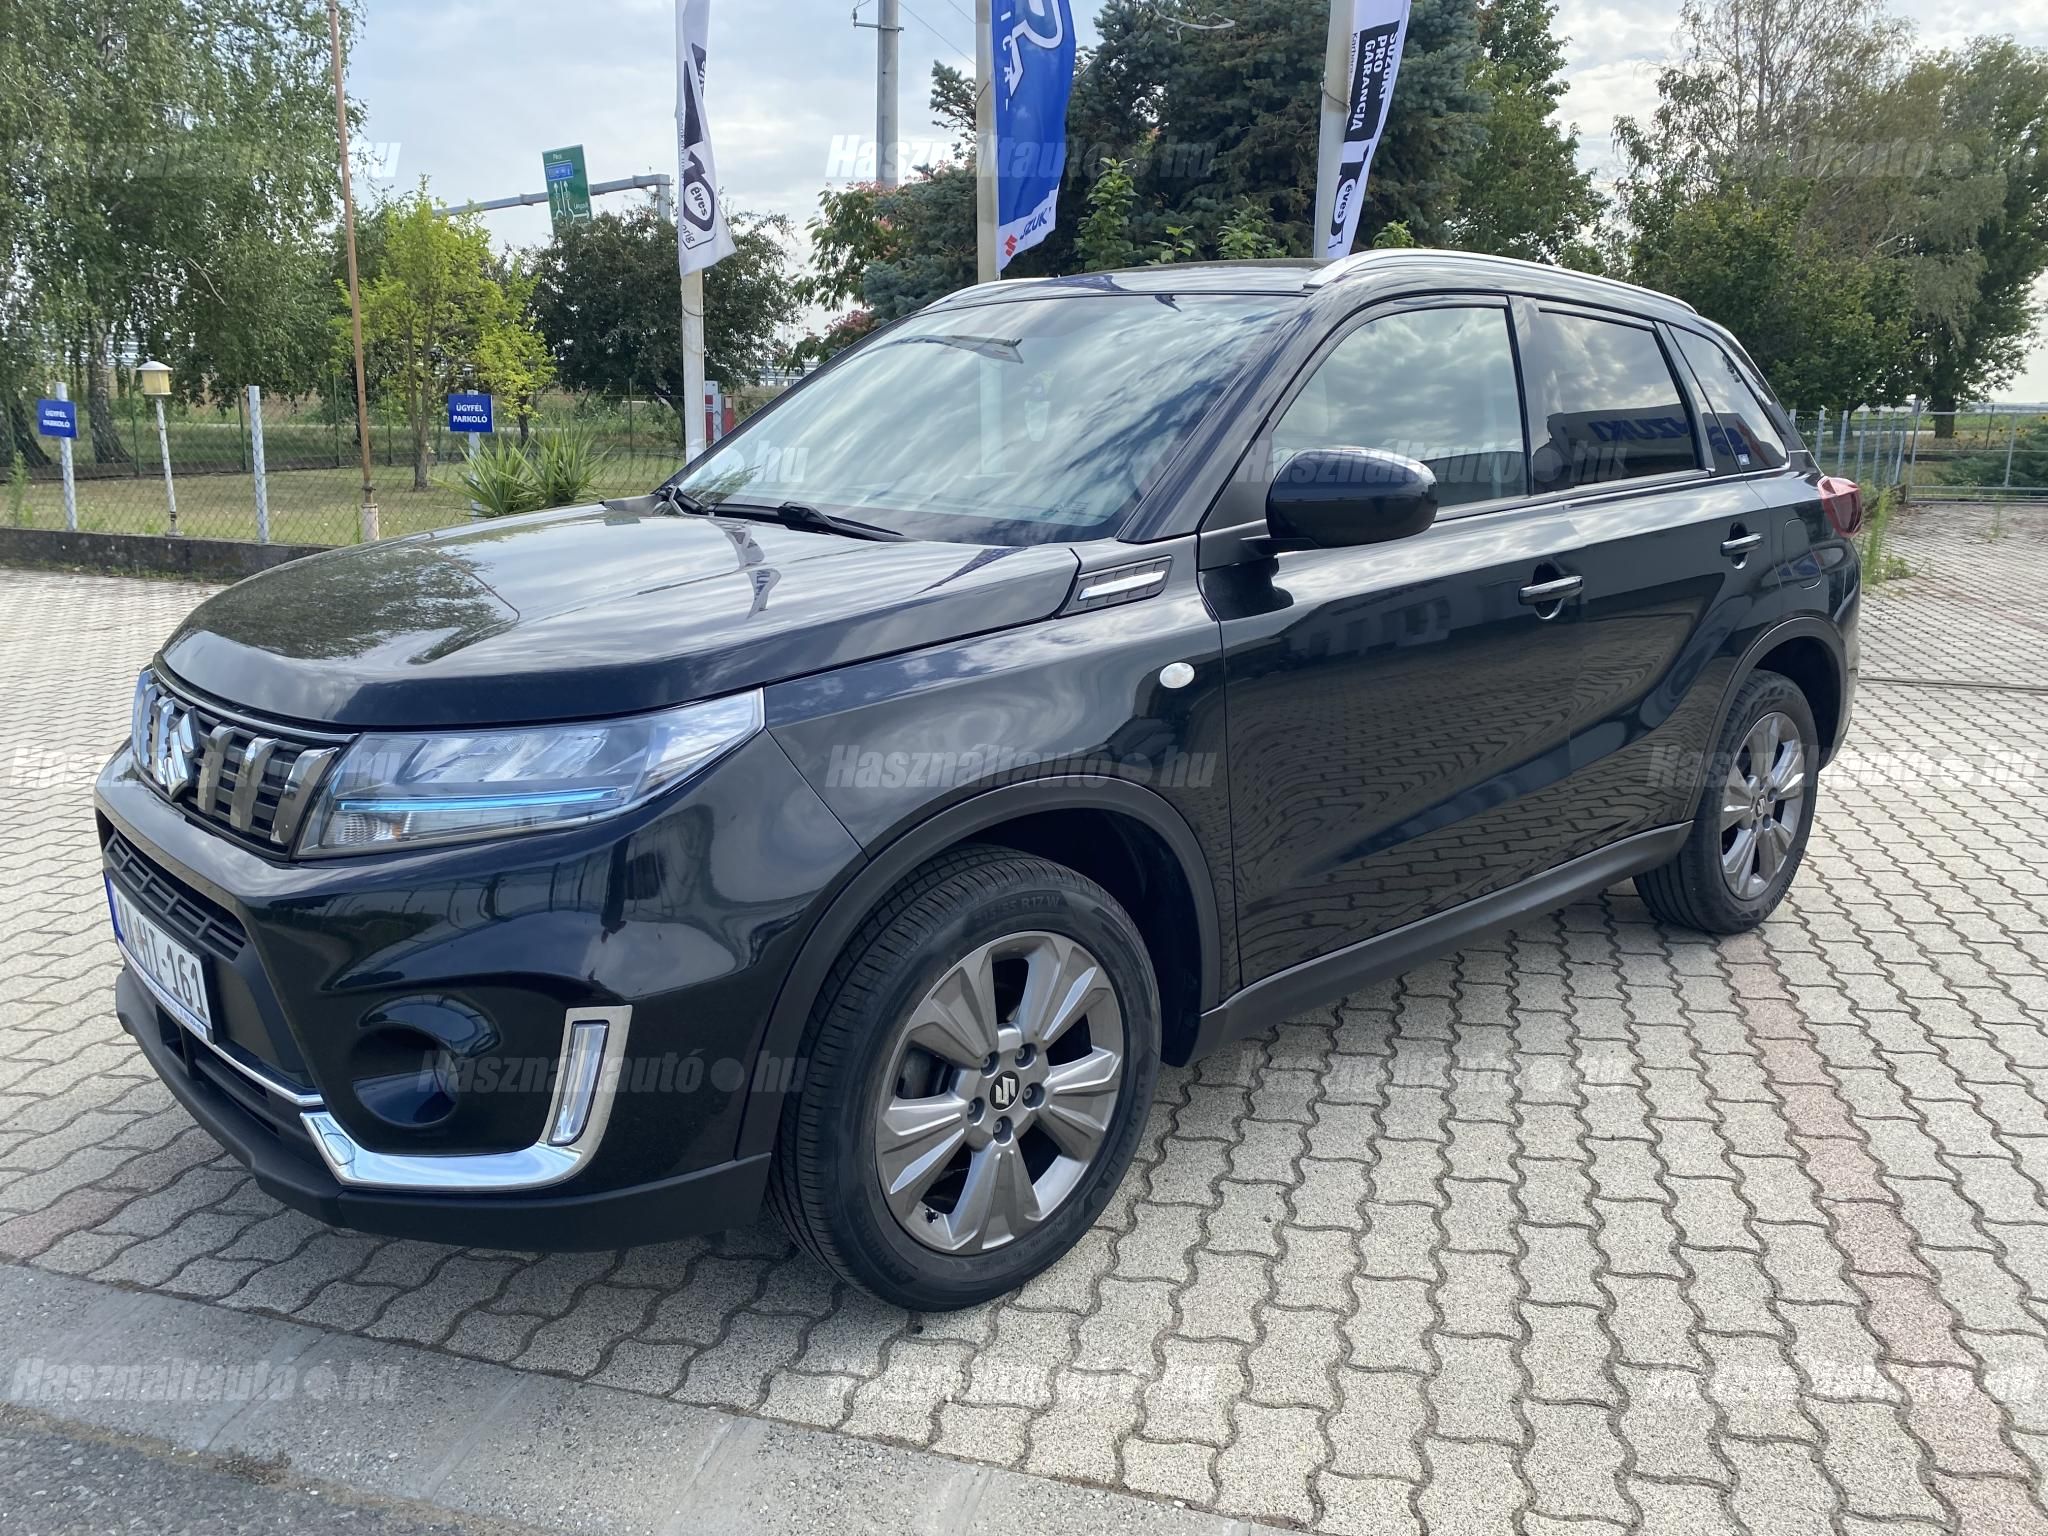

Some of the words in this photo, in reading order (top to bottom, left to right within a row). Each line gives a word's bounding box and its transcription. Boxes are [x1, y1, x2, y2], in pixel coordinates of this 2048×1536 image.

[1374, 35, 1388, 73] PRO
[1350, 40, 1376, 132] GARANCIA
[452, 413, 488, 423] PARKOLÓ
[455, 402, 484, 412] ÜGYFÉL
